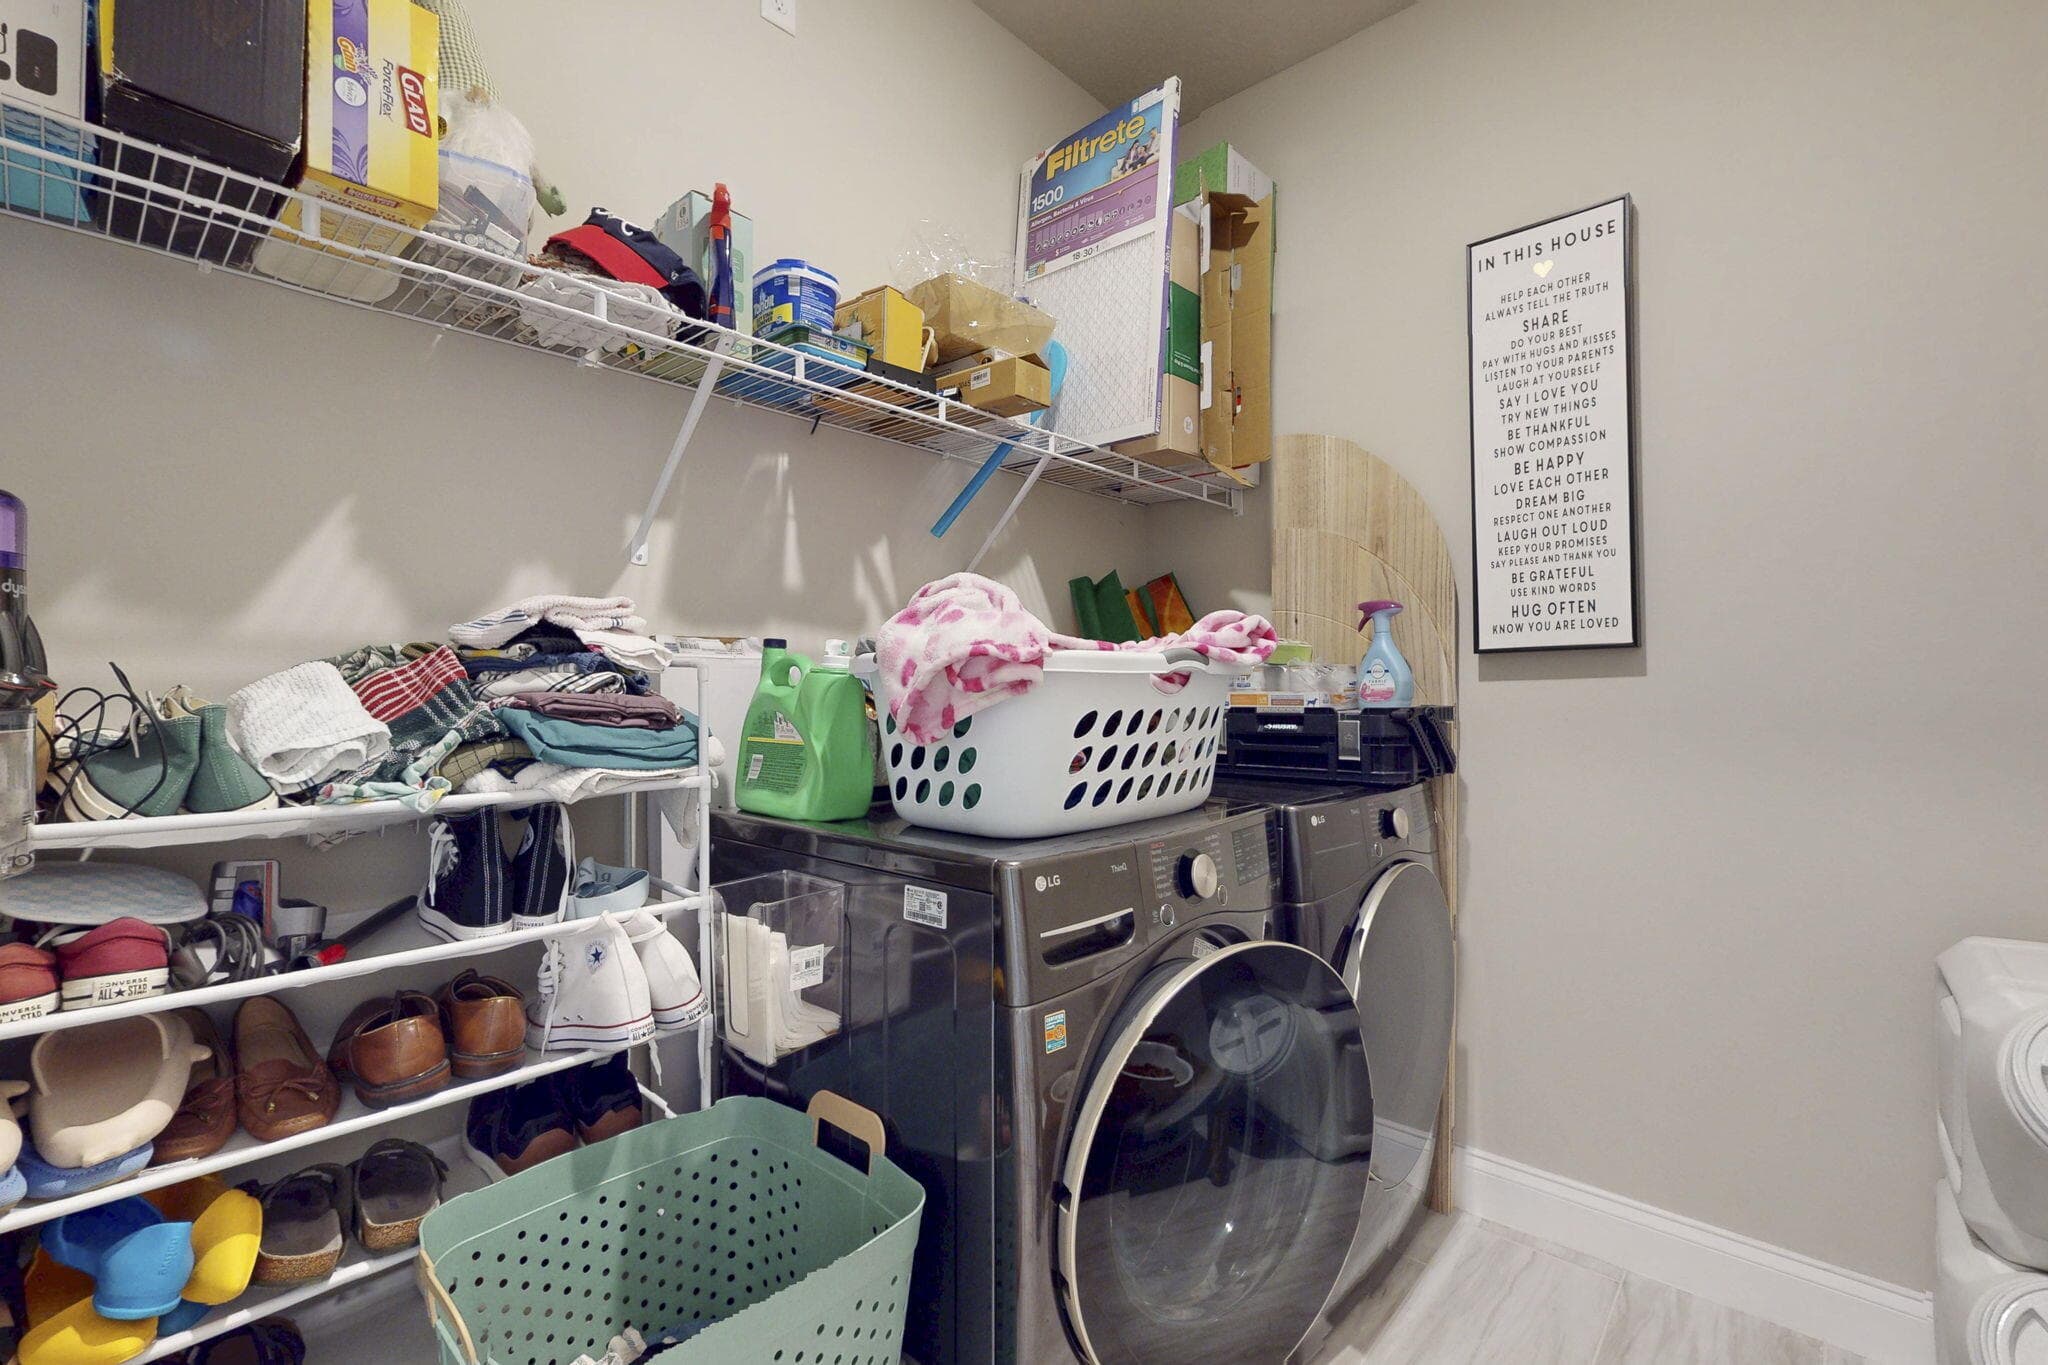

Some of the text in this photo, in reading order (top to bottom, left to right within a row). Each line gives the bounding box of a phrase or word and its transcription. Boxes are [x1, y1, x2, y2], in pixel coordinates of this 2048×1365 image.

[383, 58, 394, 117] ForceFlex
[401, 71, 427, 134] GLAD
[1046, 115, 1145, 181] Filtrete
[1031, 185, 1064, 213] 1500
[1478, 219, 1616, 273] IN THIS HOUSE
[1500, 272, 1590, 304] HELP EACH OTHER
[1485, 282, 1609, 322] ALWAYS TELL THE TRUTH
[1522, 310, 1569, 332] SHARE
[1482, 330, 1616, 369] PAY WITH HUGS AND KISSES
[1511, 324, 1583, 350] DO YOUR BEST
[1485, 345, 1615, 382] LISTEN TO YOUR PARENTS
[1497, 362, 1601, 393] LAUGH AT YOURSELF
[1499, 379, 1599, 410] SAY I LOVE YOU
[1501, 397, 1597, 425] TRY NEW THINGS
[1508, 415, 1590, 440] BE THANKFUL
[1494, 430, 1607, 458] SHOW COMPASSION
[1514, 451, 1585, 475] BE HAPPY
[1494, 468, 1609, 496] LOVE EACH OTHER
[1516, 489, 1585, 510] DREAM BIG
[1494, 503, 1612, 526] RESPECT ONE ANOTHER
[1497, 519, 1608, 543] LAUGH OUT LOUD
[1498, 535, 1608, 556] KEEP YOUR PROMISES
[1490, 548, 1617, 569] SAY PLEASE AND THANK YOU
[1511, 565, 1594, 584] BE GRATEFUL
[1510, 582, 1596, 598] USE KIND WORDS
[1511, 599, 1596, 618] HUG OFTEN
[1492, 617, 1619, 635] KNOW YOU ARE LOVED
[1048, 875, 1061, 887] LG
[98, 987, 112, 1001] ALL
[0, 1004, 42, 1017] NVERSE
